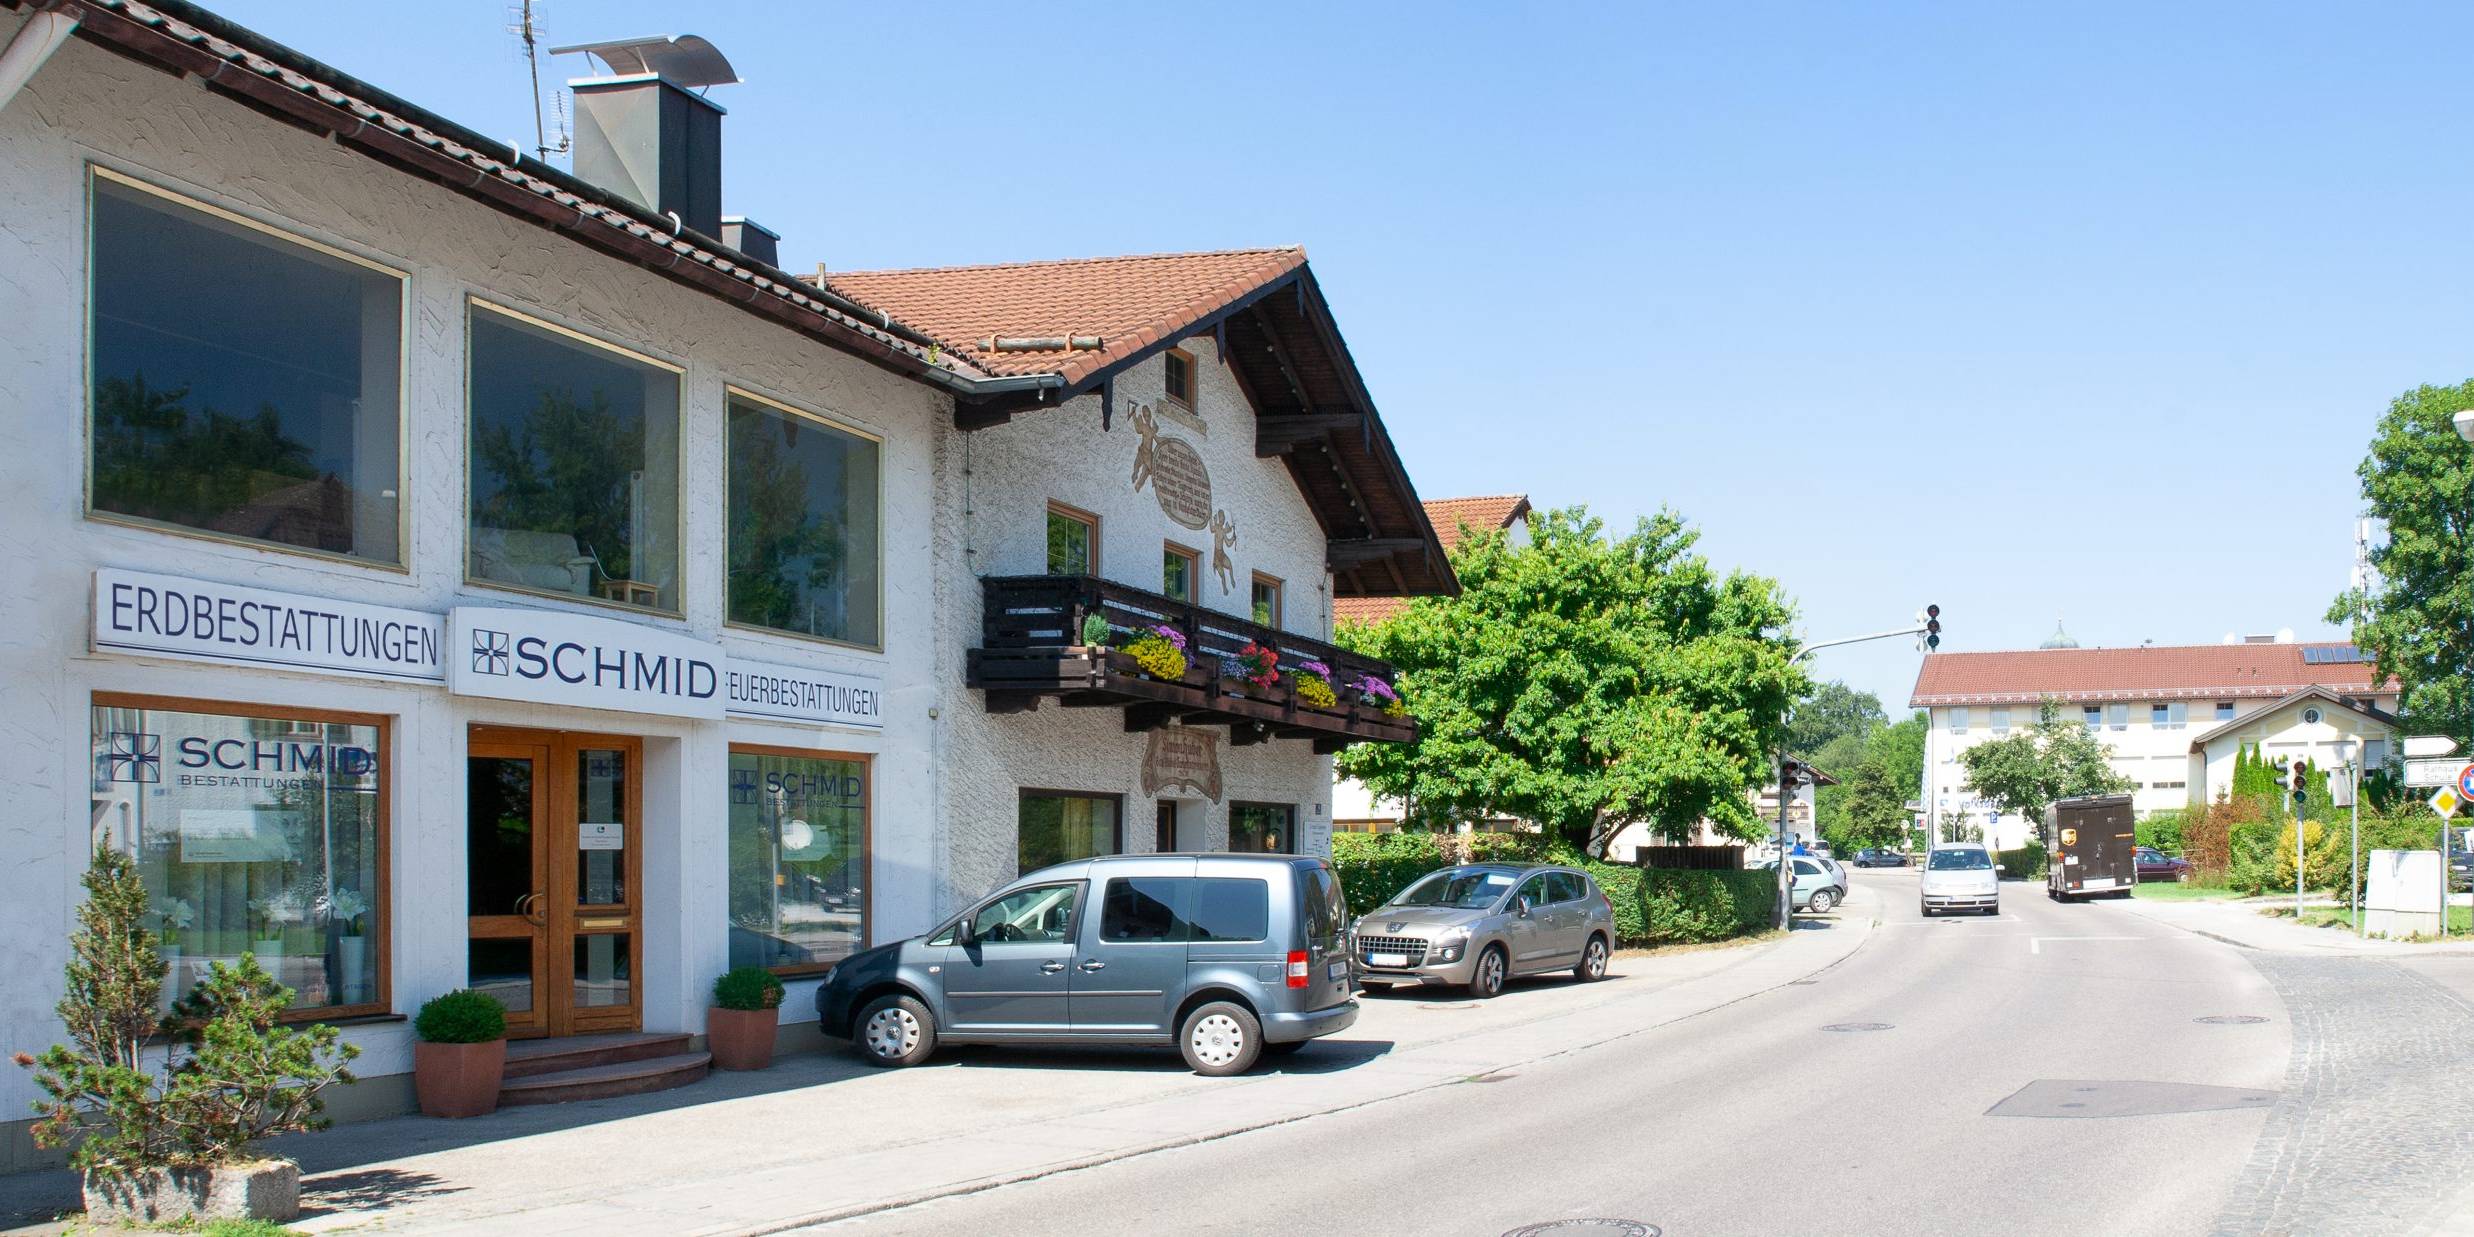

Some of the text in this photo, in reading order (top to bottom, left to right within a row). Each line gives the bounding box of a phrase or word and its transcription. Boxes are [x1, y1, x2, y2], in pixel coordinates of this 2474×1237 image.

[112, 583, 437, 666] ERDBESTATTUNGEN
[515, 637, 717, 699] SCHMID
[725, 671, 879, 717] EUERBESTATTUNGEN
[178, 736, 373, 777] SCHMID
[179, 774, 323, 791] BESTATTUNGEN
[766, 771, 861, 797] SCHMID
